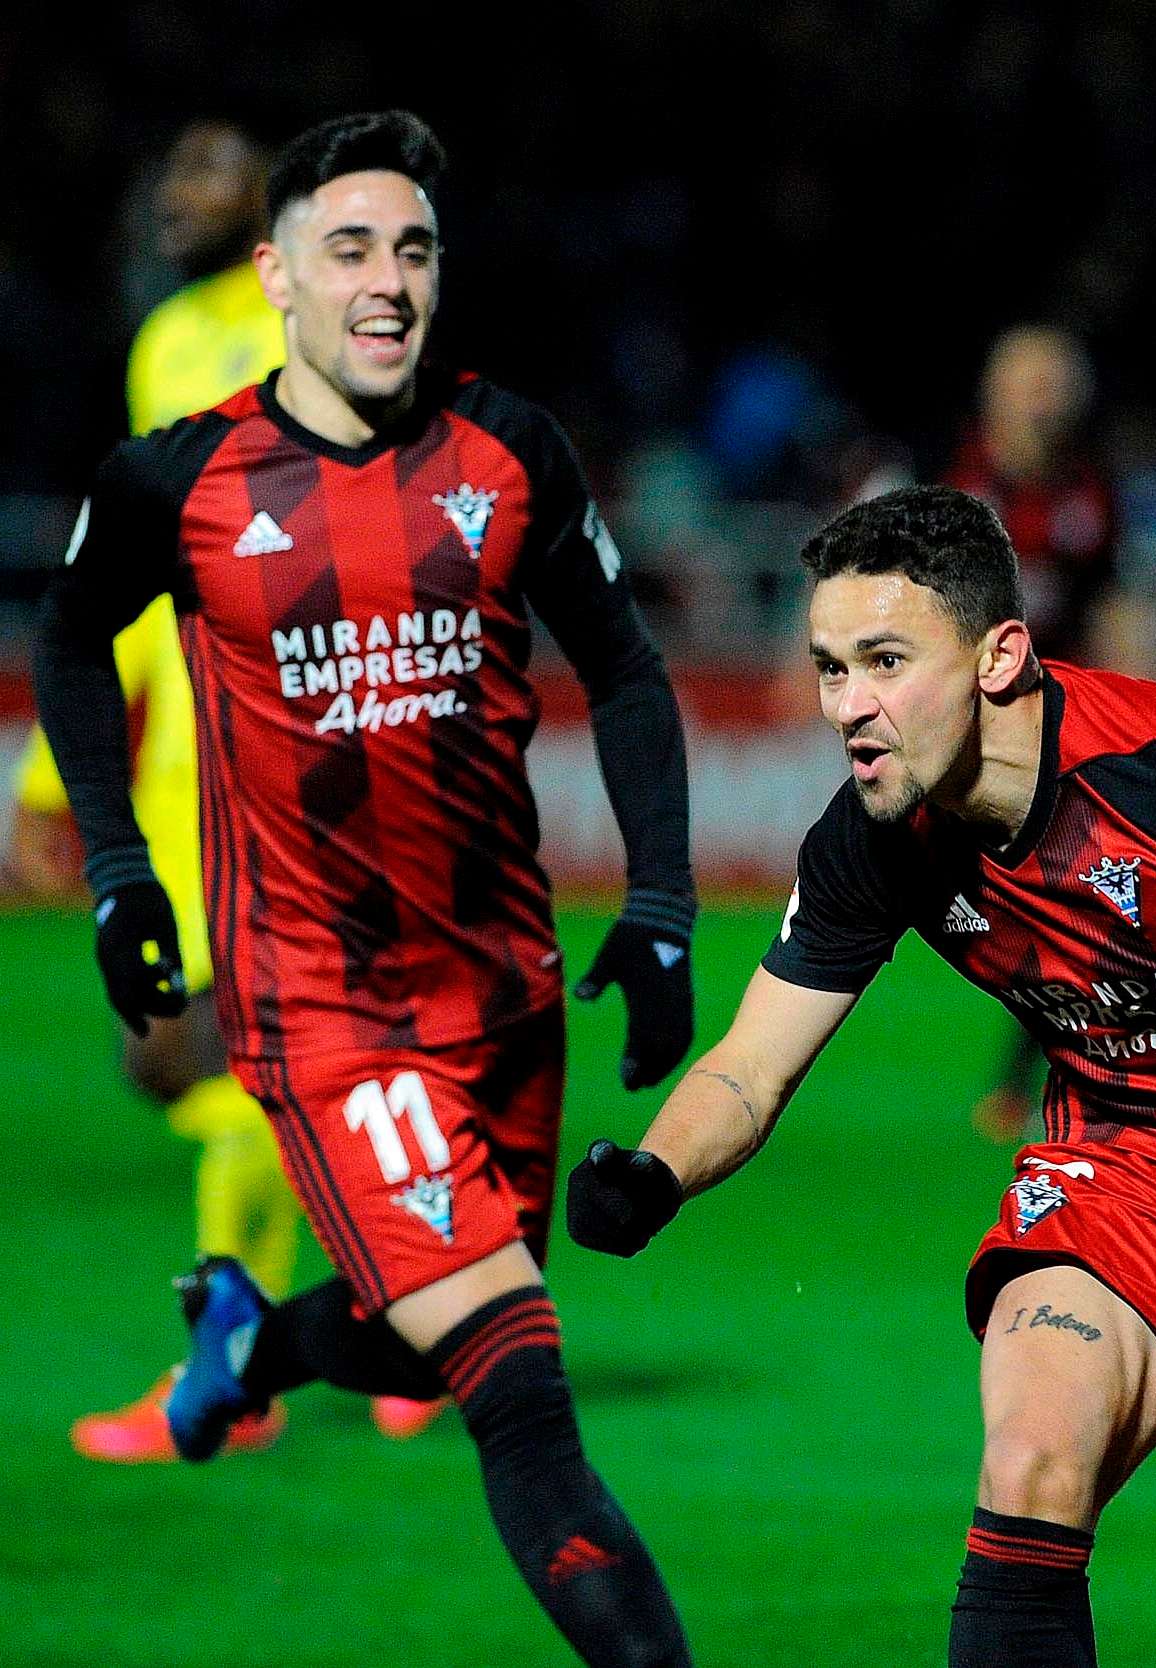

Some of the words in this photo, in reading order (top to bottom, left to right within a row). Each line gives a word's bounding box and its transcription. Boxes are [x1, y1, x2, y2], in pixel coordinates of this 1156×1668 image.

[271, 607, 483, 664] MIRANDA
[278, 640, 485, 699] EMPRESAS
[314, 688, 468, 736] Ahora.
[942, 917, 991, 934] adidas
[341, 1070, 452, 1185] 11
[1004, 1307, 1028, 1334] I
[1029, 1304, 1103, 1341] Belong
